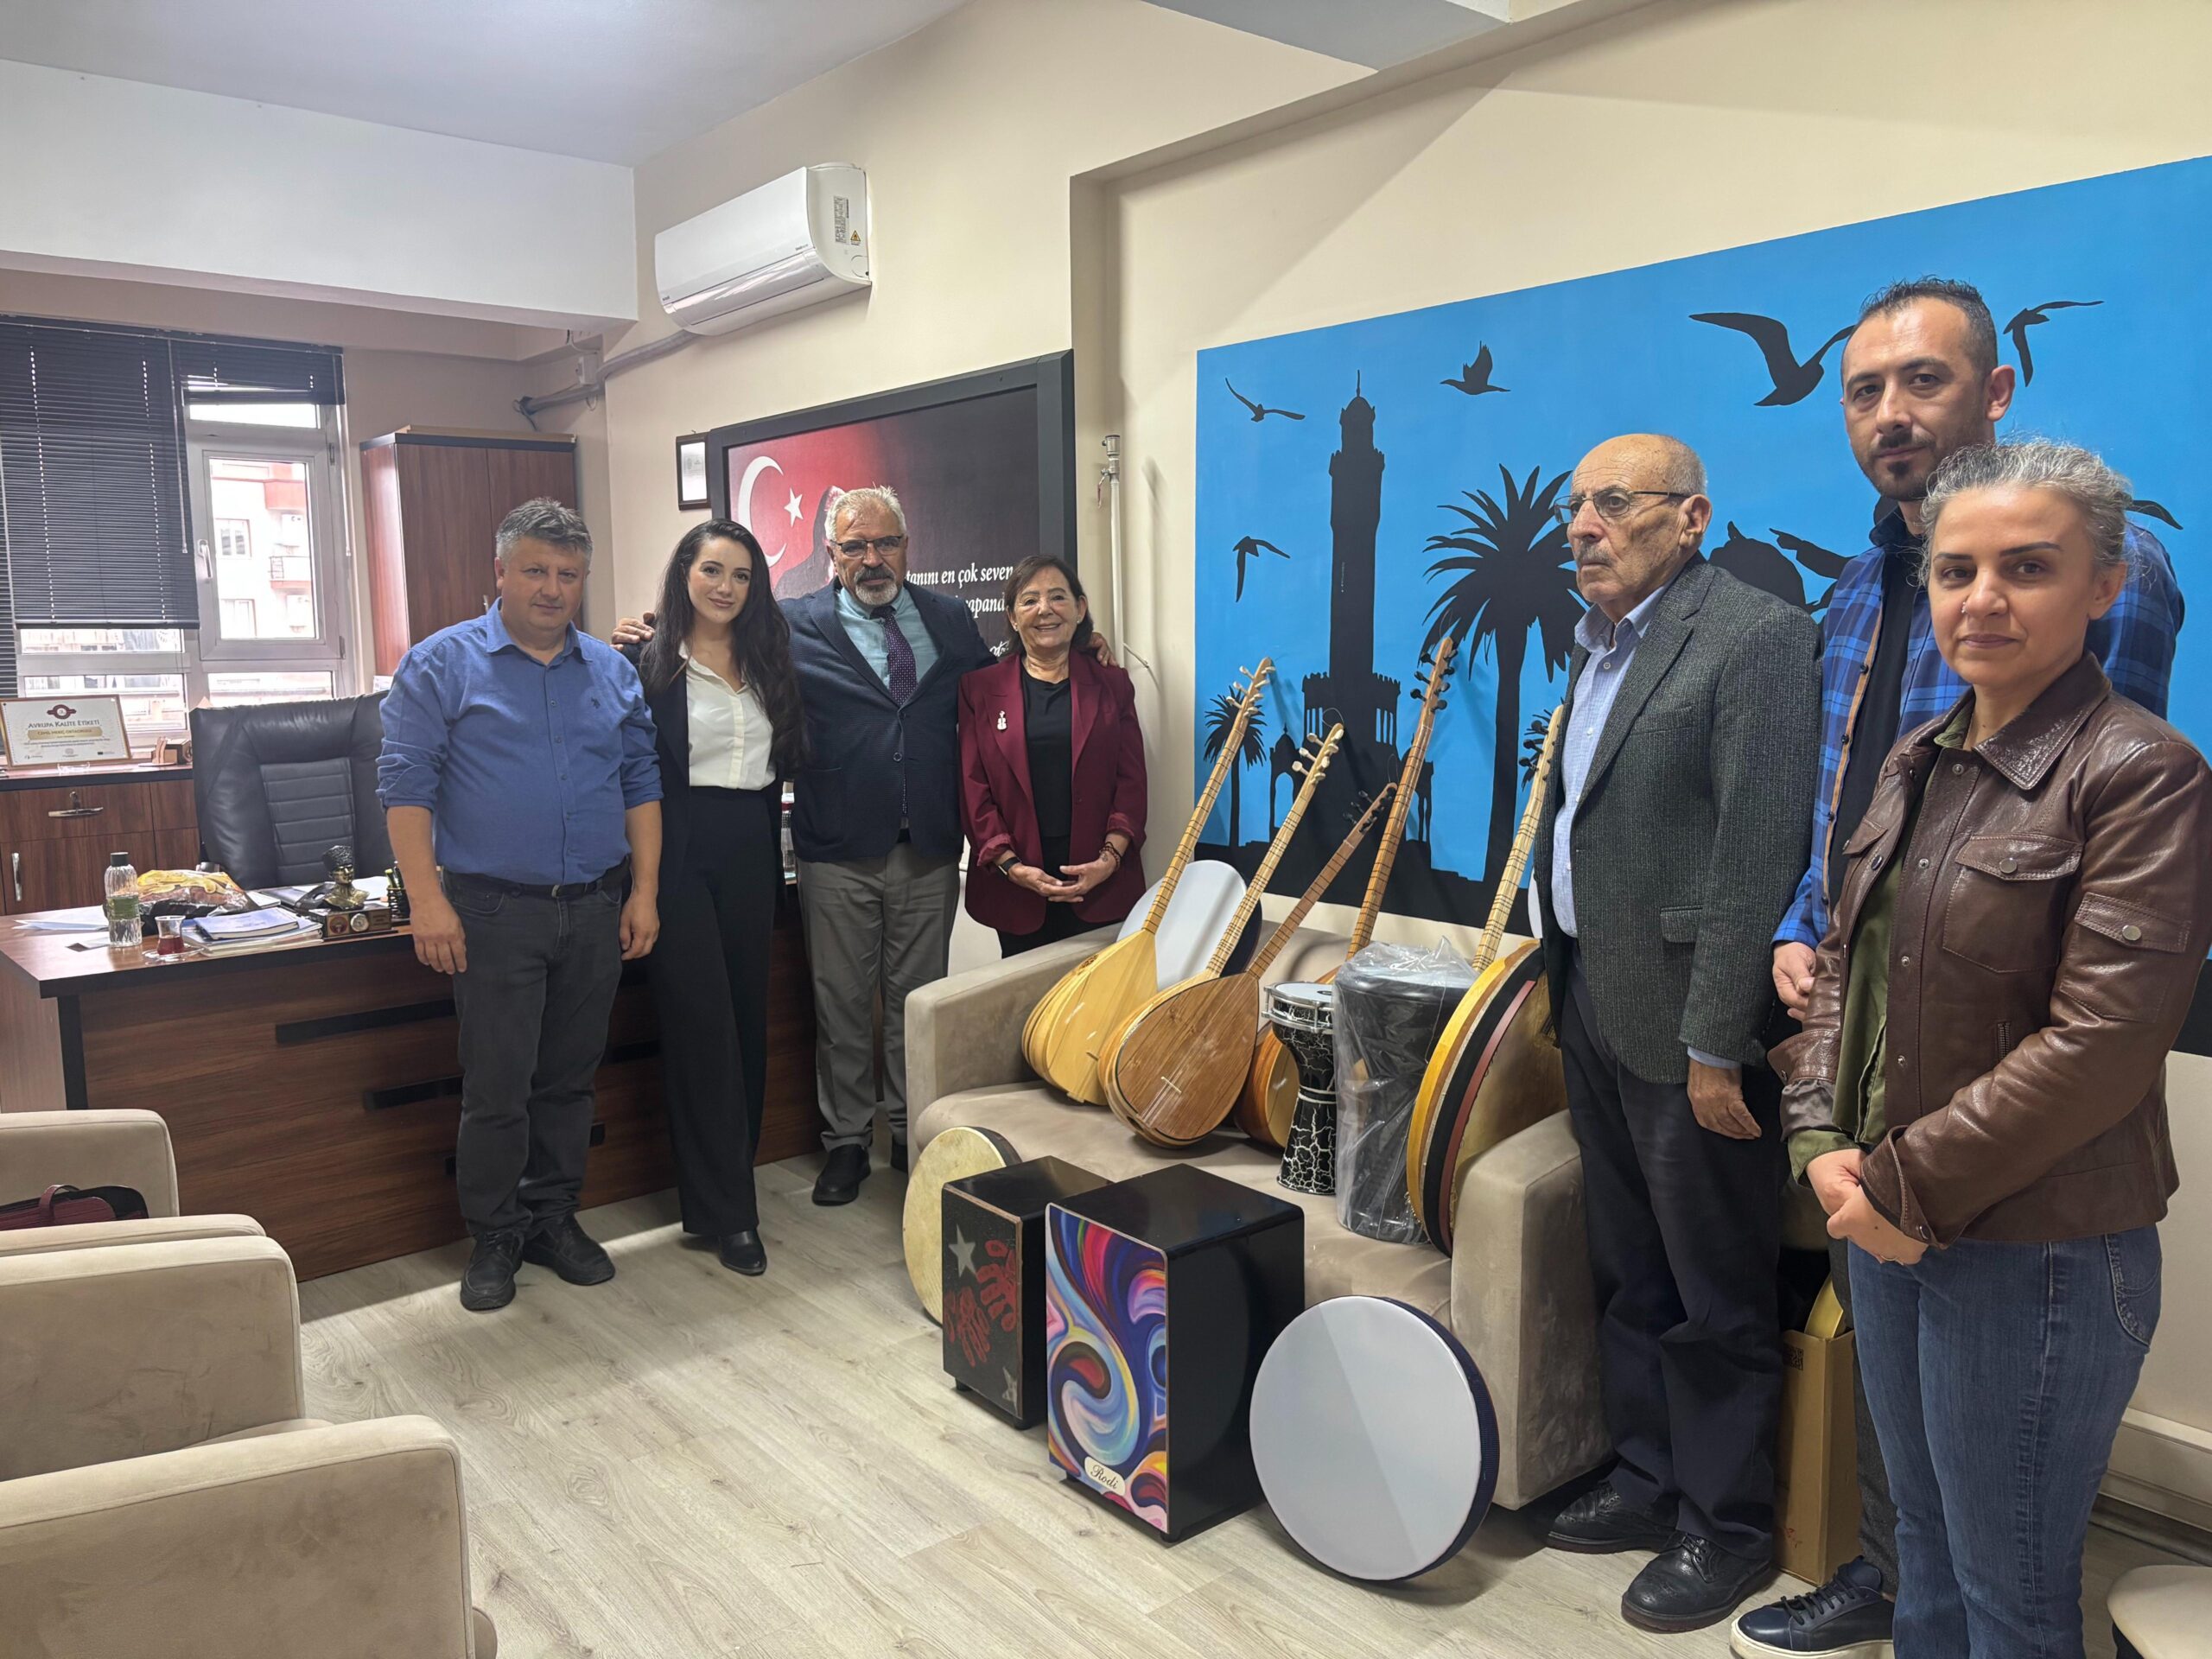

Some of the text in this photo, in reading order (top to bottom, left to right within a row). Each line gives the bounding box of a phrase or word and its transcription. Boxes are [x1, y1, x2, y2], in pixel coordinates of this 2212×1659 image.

[905, 569, 938, 586] tanını
[941, 569, 956, 585] en
[958, 563, 978, 589] çok
[1090, 1465, 1118, 1489] Rodi
